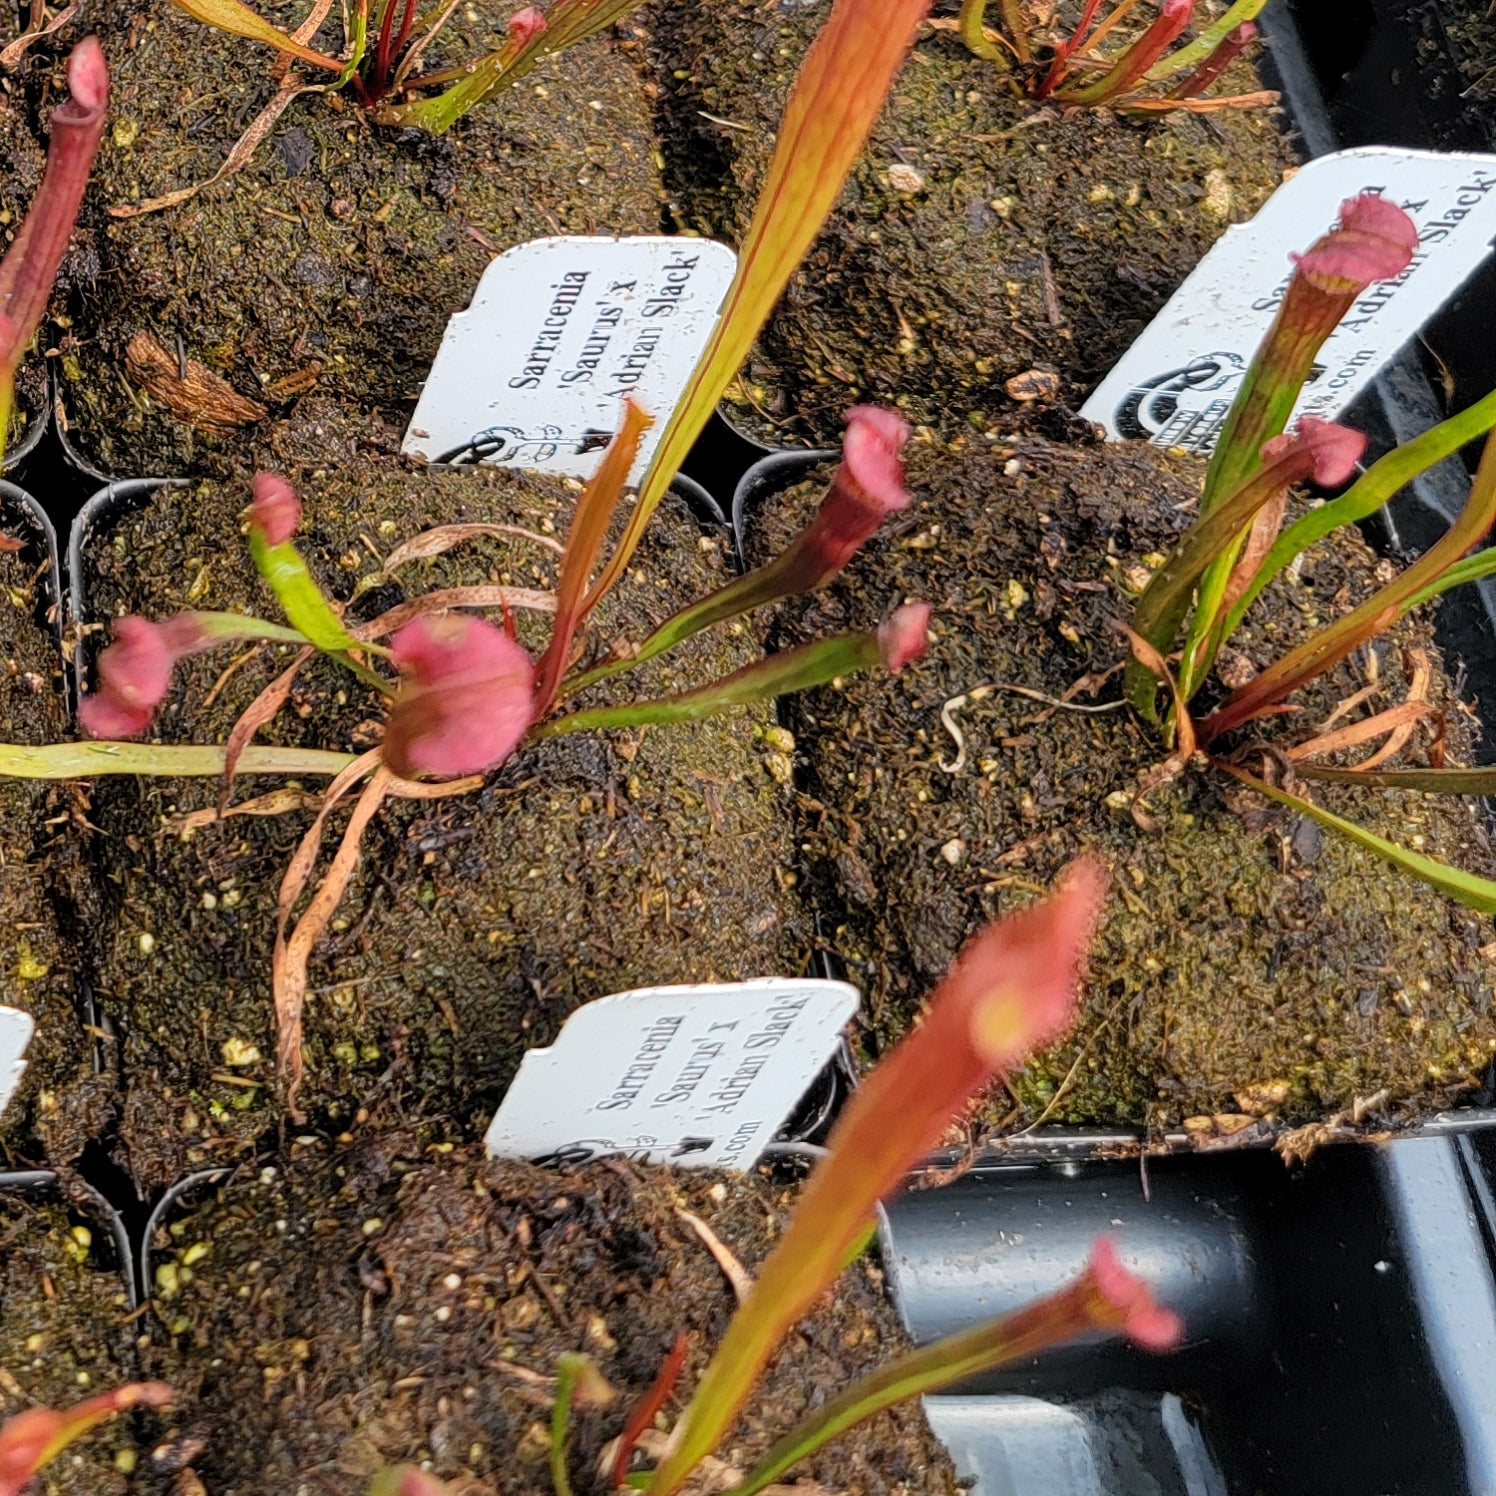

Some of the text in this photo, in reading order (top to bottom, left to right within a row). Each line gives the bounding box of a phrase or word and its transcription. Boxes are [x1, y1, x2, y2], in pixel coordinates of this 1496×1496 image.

[1418, 169, 1496, 244] Slack'
[507, 270, 592, 390] Sarracenia
[641, 250, 701, 318] Slack'
[557, 277, 638, 390] 'Saurus' x
[596, 1014, 686, 1111] Sarracenia
[650, 1036, 725, 1109] 'Saurus'
[694, 994, 814, 1120] 'Adrian Slack'
